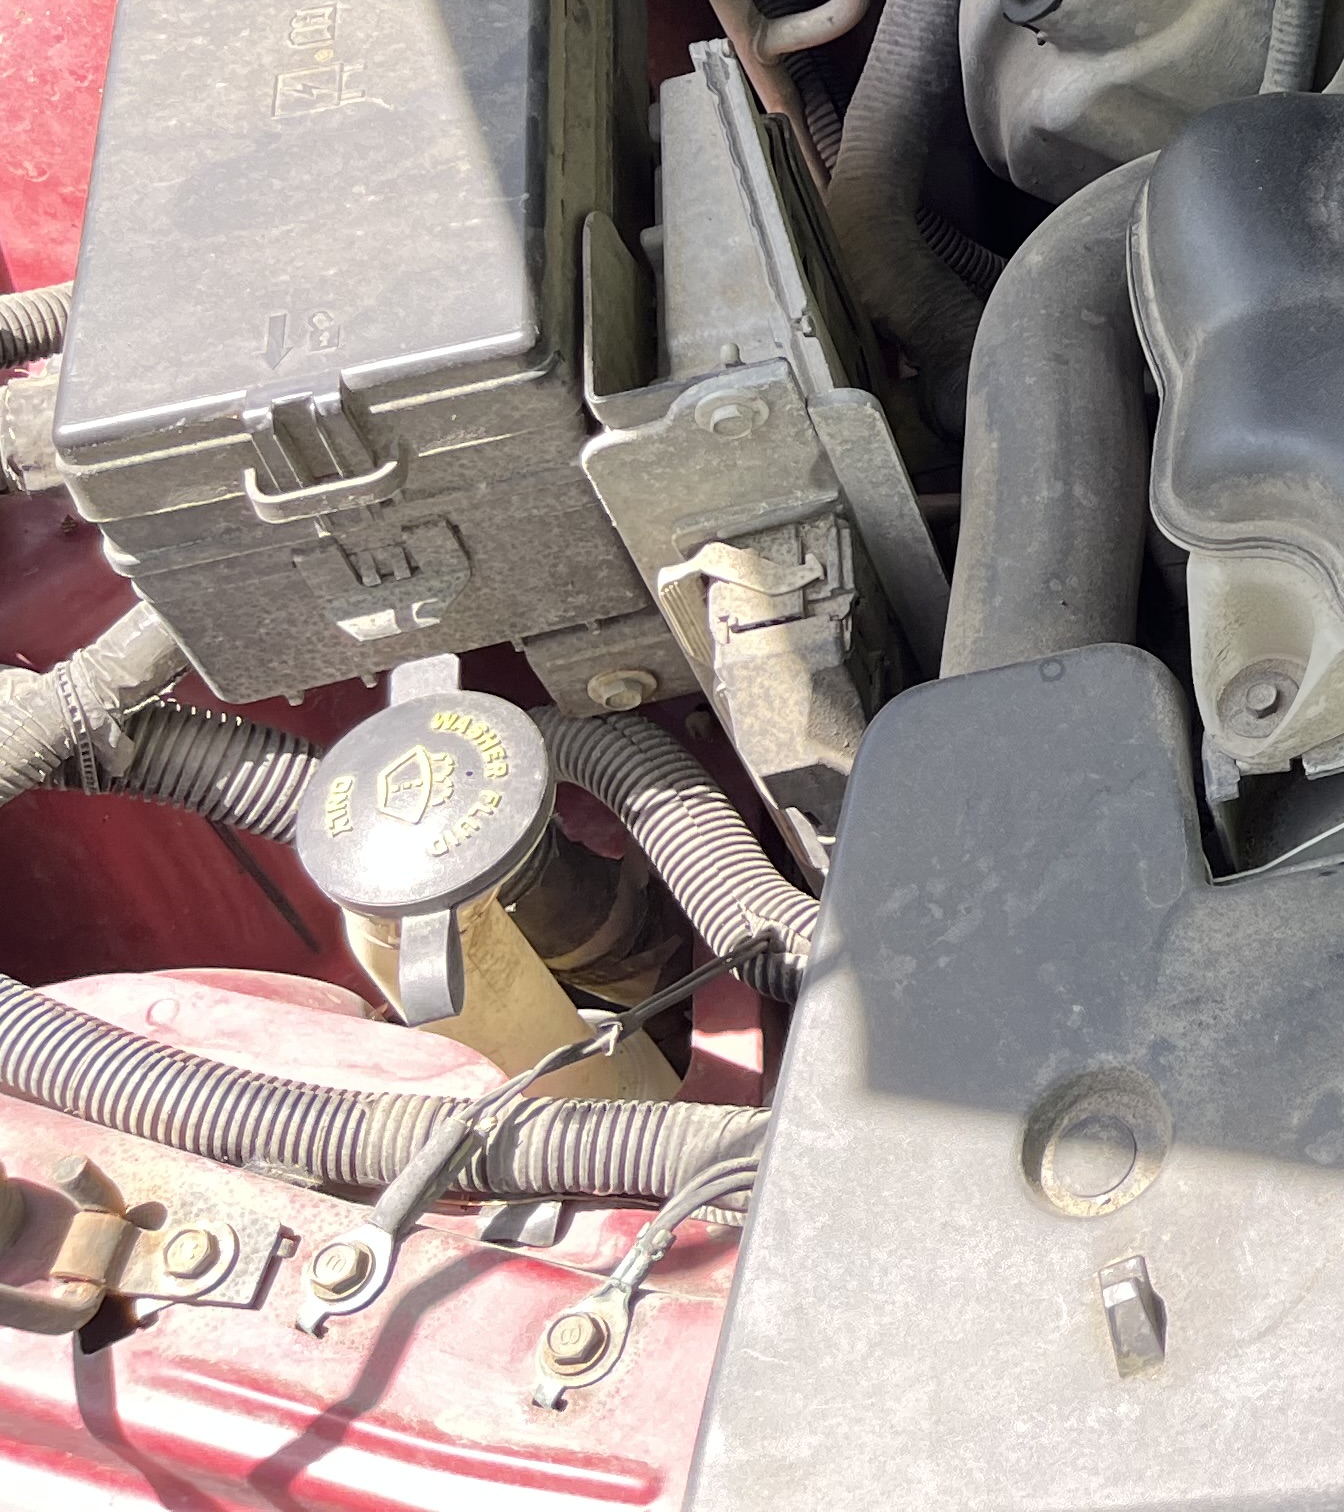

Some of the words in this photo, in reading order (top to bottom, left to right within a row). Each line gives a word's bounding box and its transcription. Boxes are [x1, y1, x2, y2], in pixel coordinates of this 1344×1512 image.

[430, 711, 508, 780] WASHER
[324, 774, 354, 838] ONLY
[427, 789, 502, 857] FLUID
